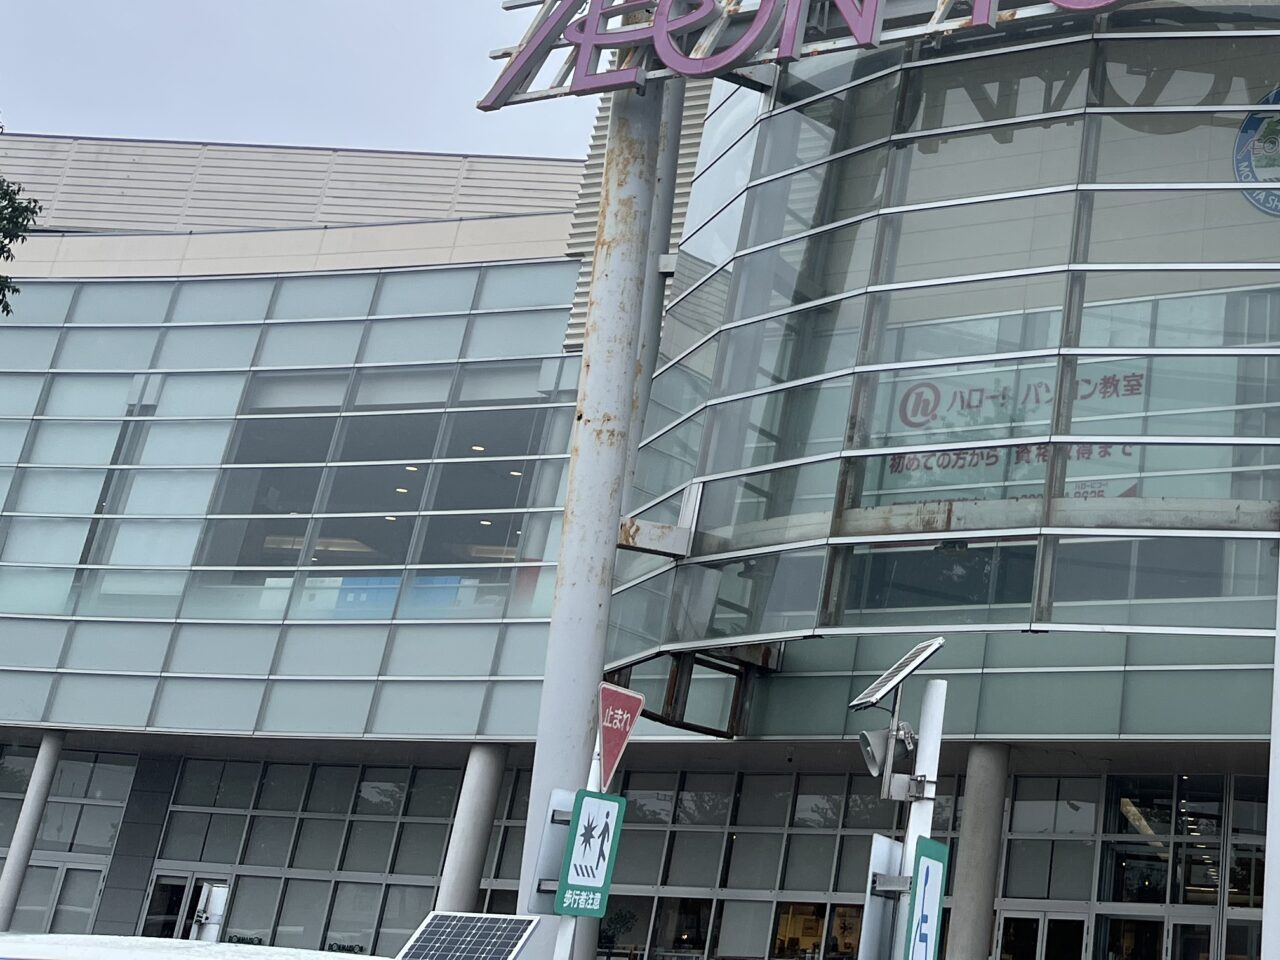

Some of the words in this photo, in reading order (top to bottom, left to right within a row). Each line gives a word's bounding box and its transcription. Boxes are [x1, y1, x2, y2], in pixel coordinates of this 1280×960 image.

[889, 450, 1000, 474] 初めての方から
[603, 706, 632, 732] 止まれ
[563, 889, 602, 910] 歩行者注意
